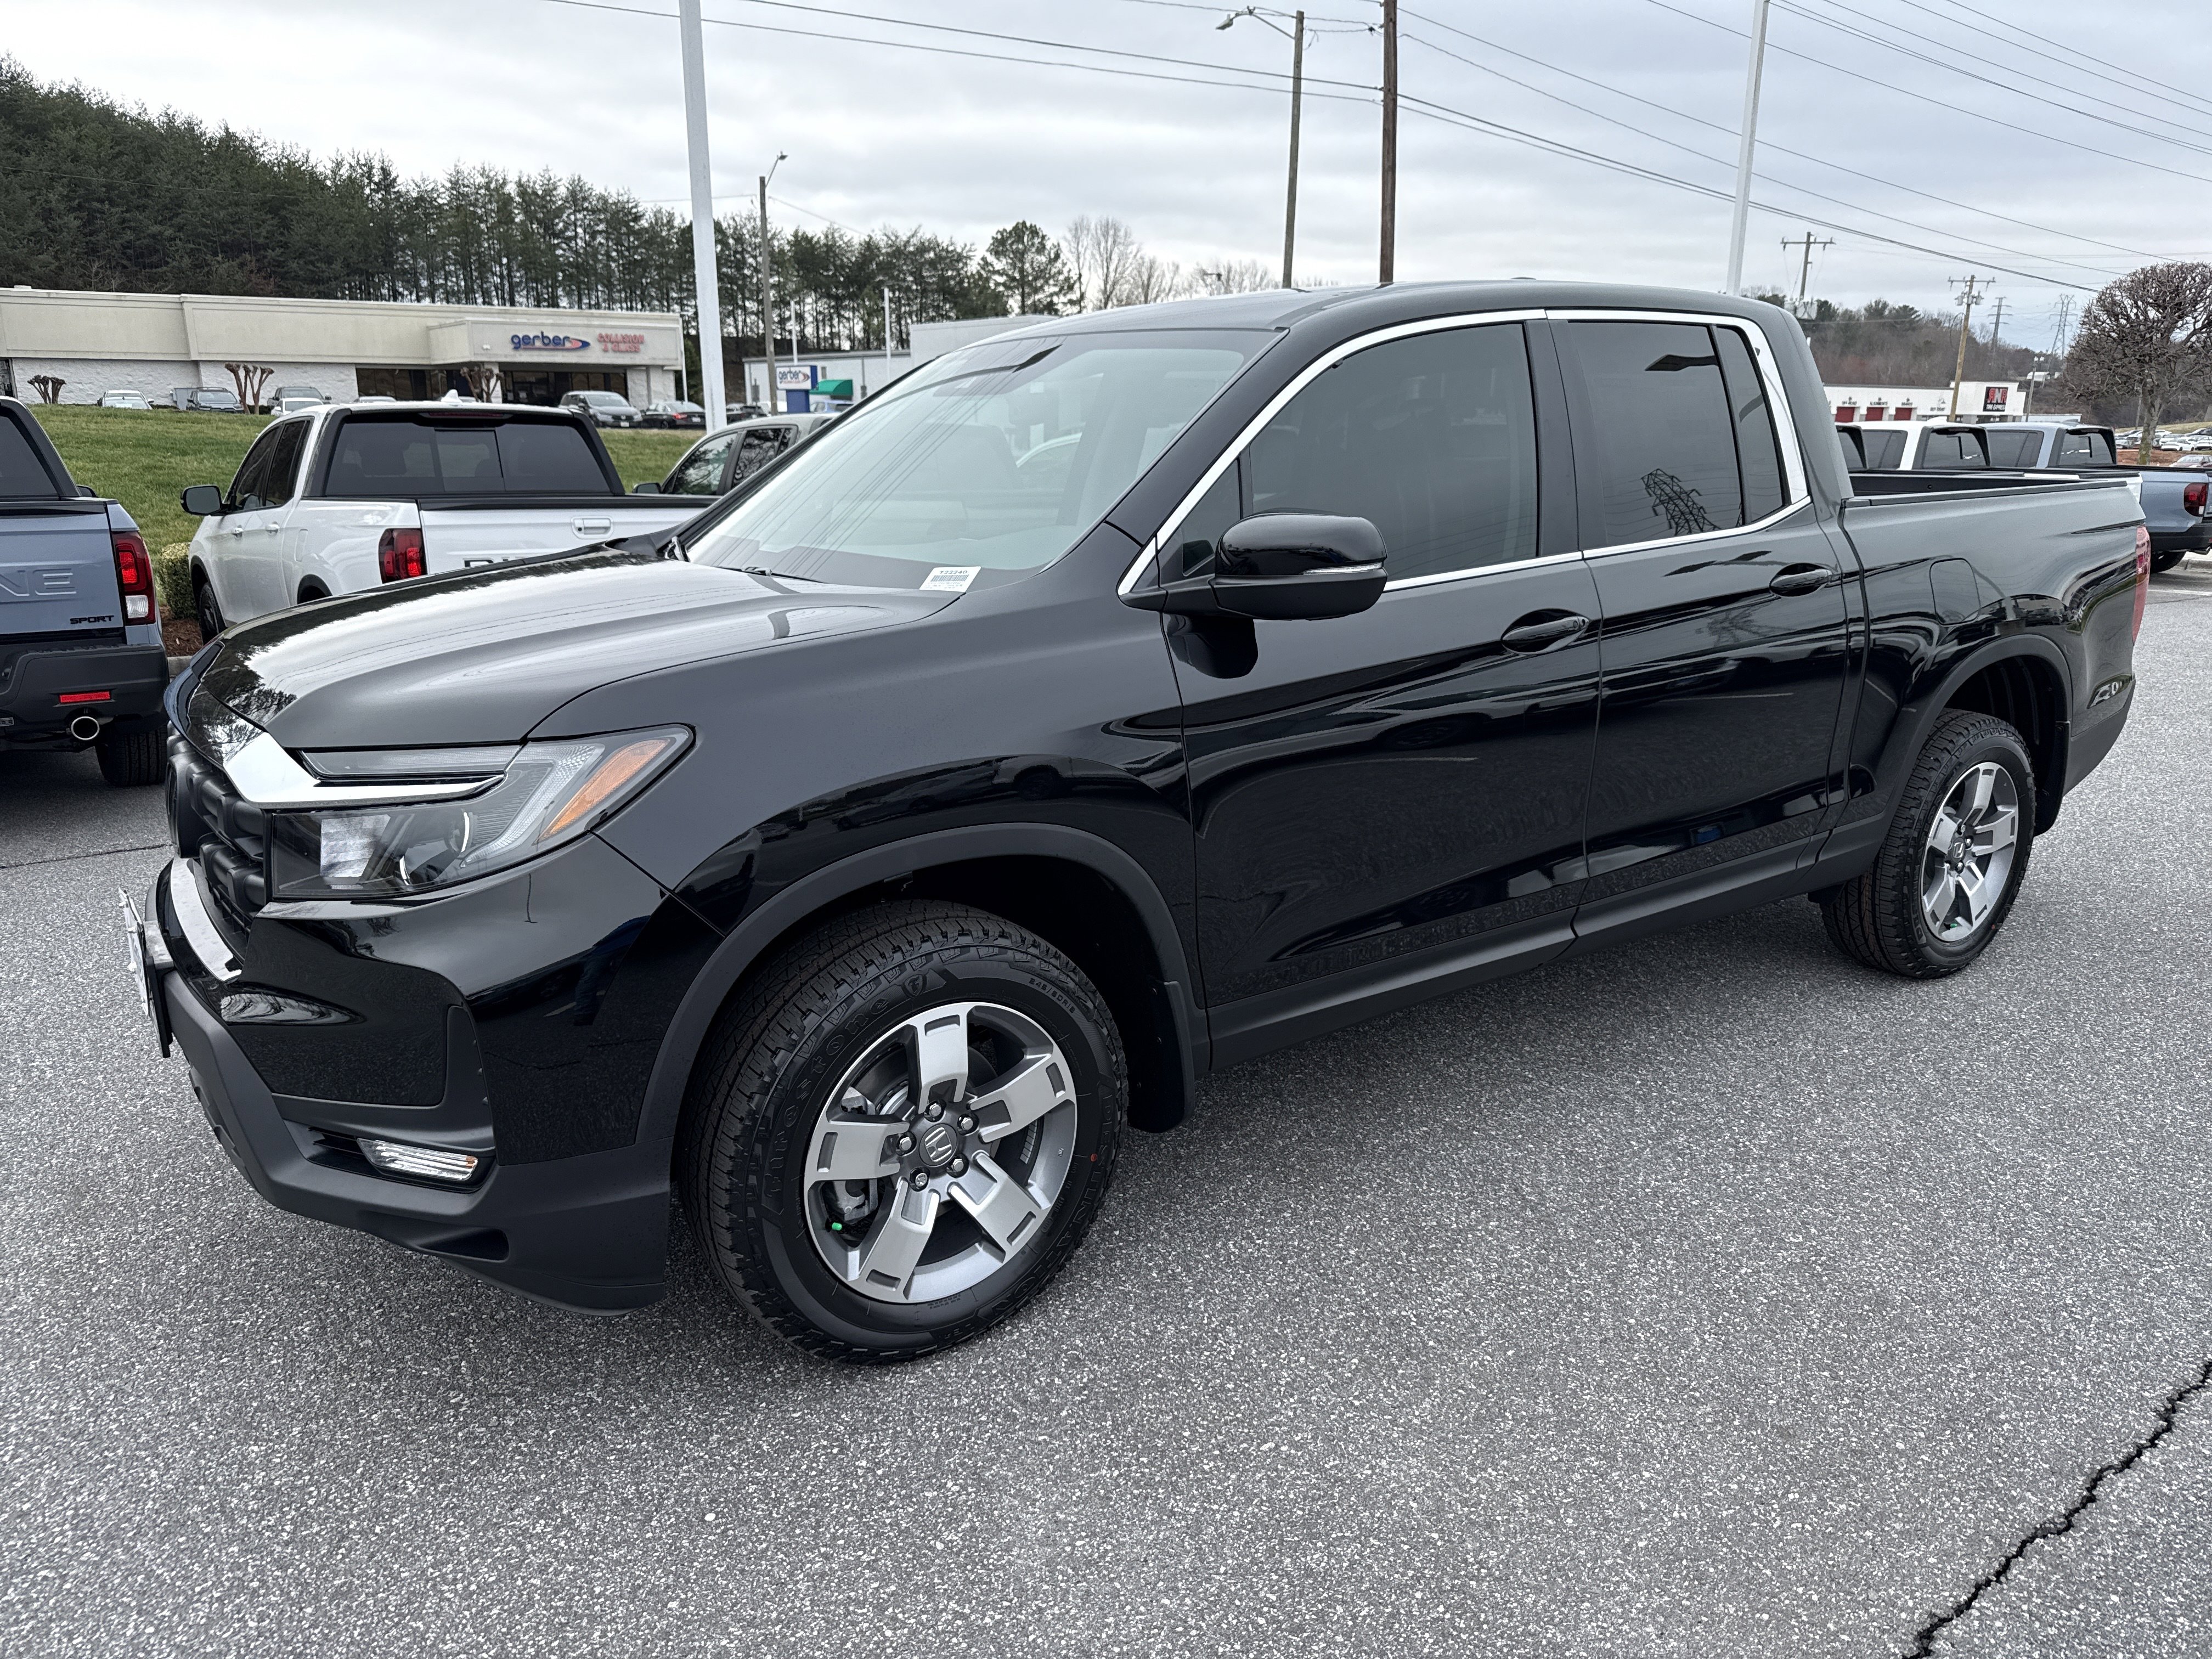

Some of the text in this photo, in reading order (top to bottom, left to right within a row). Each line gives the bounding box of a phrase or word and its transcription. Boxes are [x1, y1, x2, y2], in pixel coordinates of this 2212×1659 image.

[511, 331, 571, 350] gerber
[597, 332, 645, 343] COLLISION
[612, 343, 641, 352] GLASS
[778, 367, 802, 384] gerber
[70, 615, 114, 624] SPORT
[991, 1094, 1115, 1316] DESTINATION
